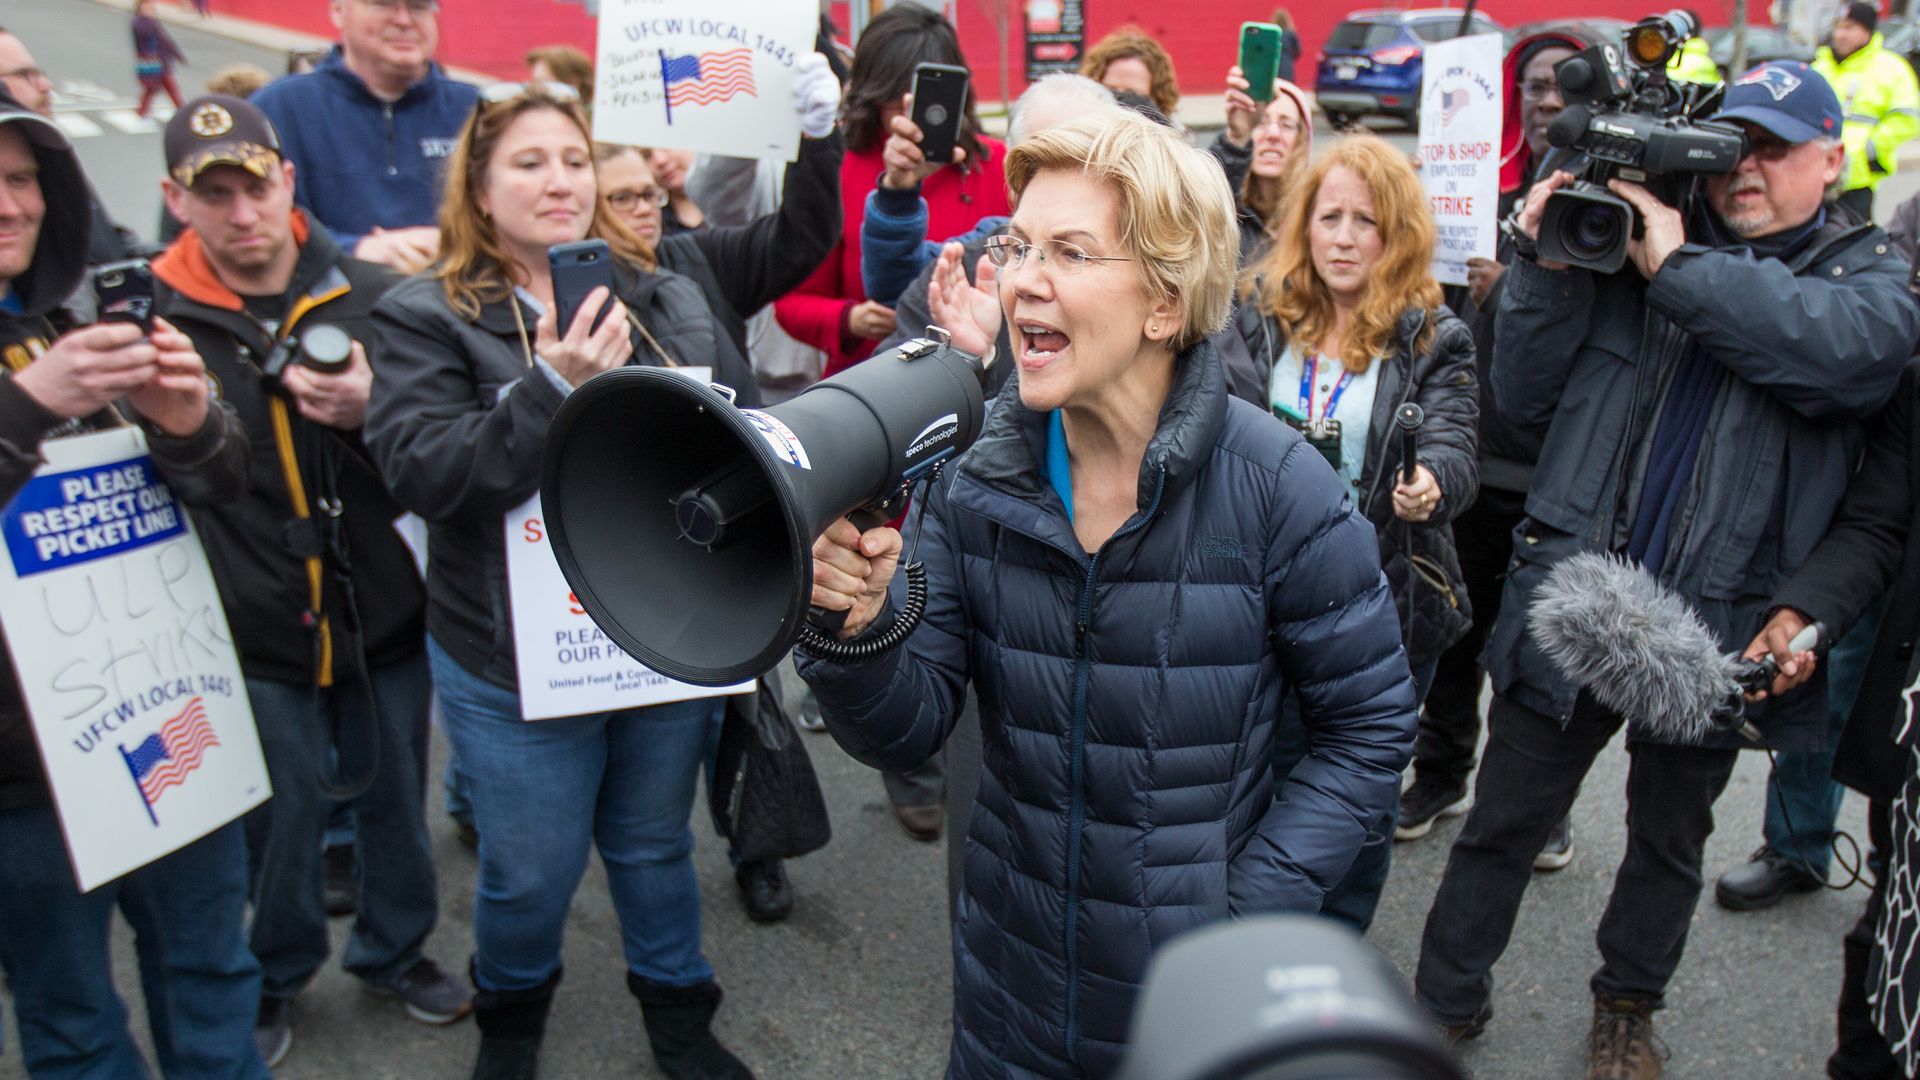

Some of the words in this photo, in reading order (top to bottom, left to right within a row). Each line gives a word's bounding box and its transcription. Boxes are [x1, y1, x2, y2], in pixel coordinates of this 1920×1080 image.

[624, 18, 683, 42] UFCW
[690, 21, 749, 45] LOCAL
[756, 34, 796, 68] 1445
[1421, 144, 1443, 161] TOP
[1448, 143, 1456, 160] &
[1460, 142, 1491, 160] SHOP
[1430, 163, 1477, 177] EMPLOYEES
[1430, 196, 1473, 217] STRIKE
[1448, 225, 1478, 238] RESPECT
[905, 443, 924, 458] speco
[923, 423, 958, 448] technologies
[65, 465, 146, 503] PLEASE
[23, 496, 136, 538] RESPECT
[37, 522, 130, 560] PICKET
[42, 541, 191, 636] ULP
[556, 627, 606, 645] PLEA
[558, 645, 601, 664] OUR
[549, 676, 585, 690] United
[587, 673, 612, 685] Food
[616, 672, 623, 681] &
[615, 680, 642, 692] Local
[74, 701, 135, 753] UFCW
[138, 676, 197, 712] LOCAL
[199, 674, 235, 699] 1445
